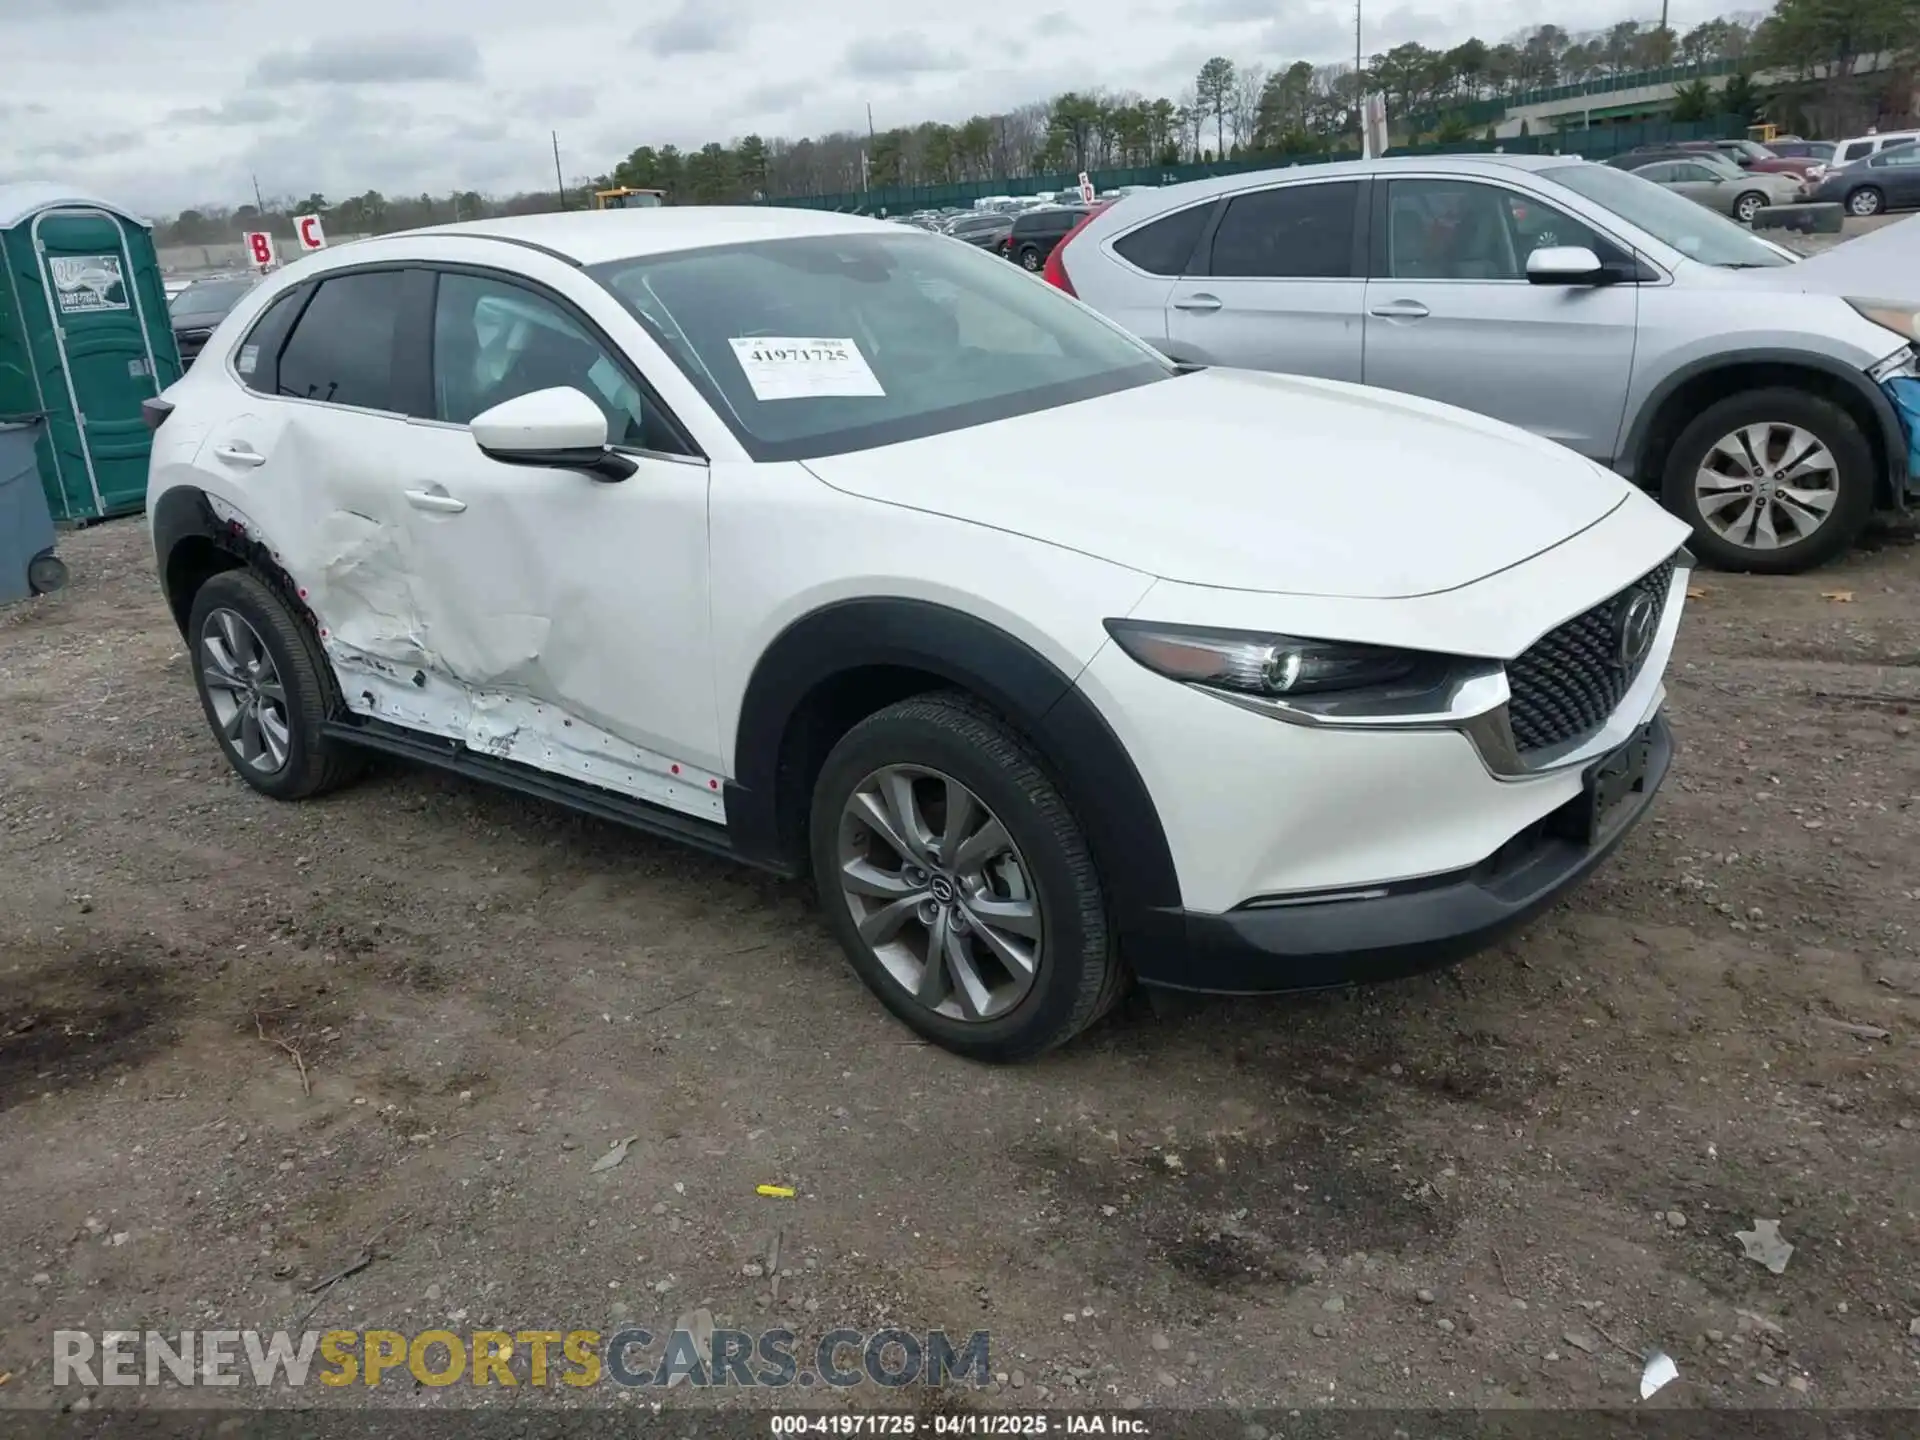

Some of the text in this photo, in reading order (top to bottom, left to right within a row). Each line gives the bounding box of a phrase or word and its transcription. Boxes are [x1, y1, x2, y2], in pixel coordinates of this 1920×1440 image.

[302, 218, 320, 247] C
[251, 234, 271, 262] B
[751, 349, 849, 362] 41971725
